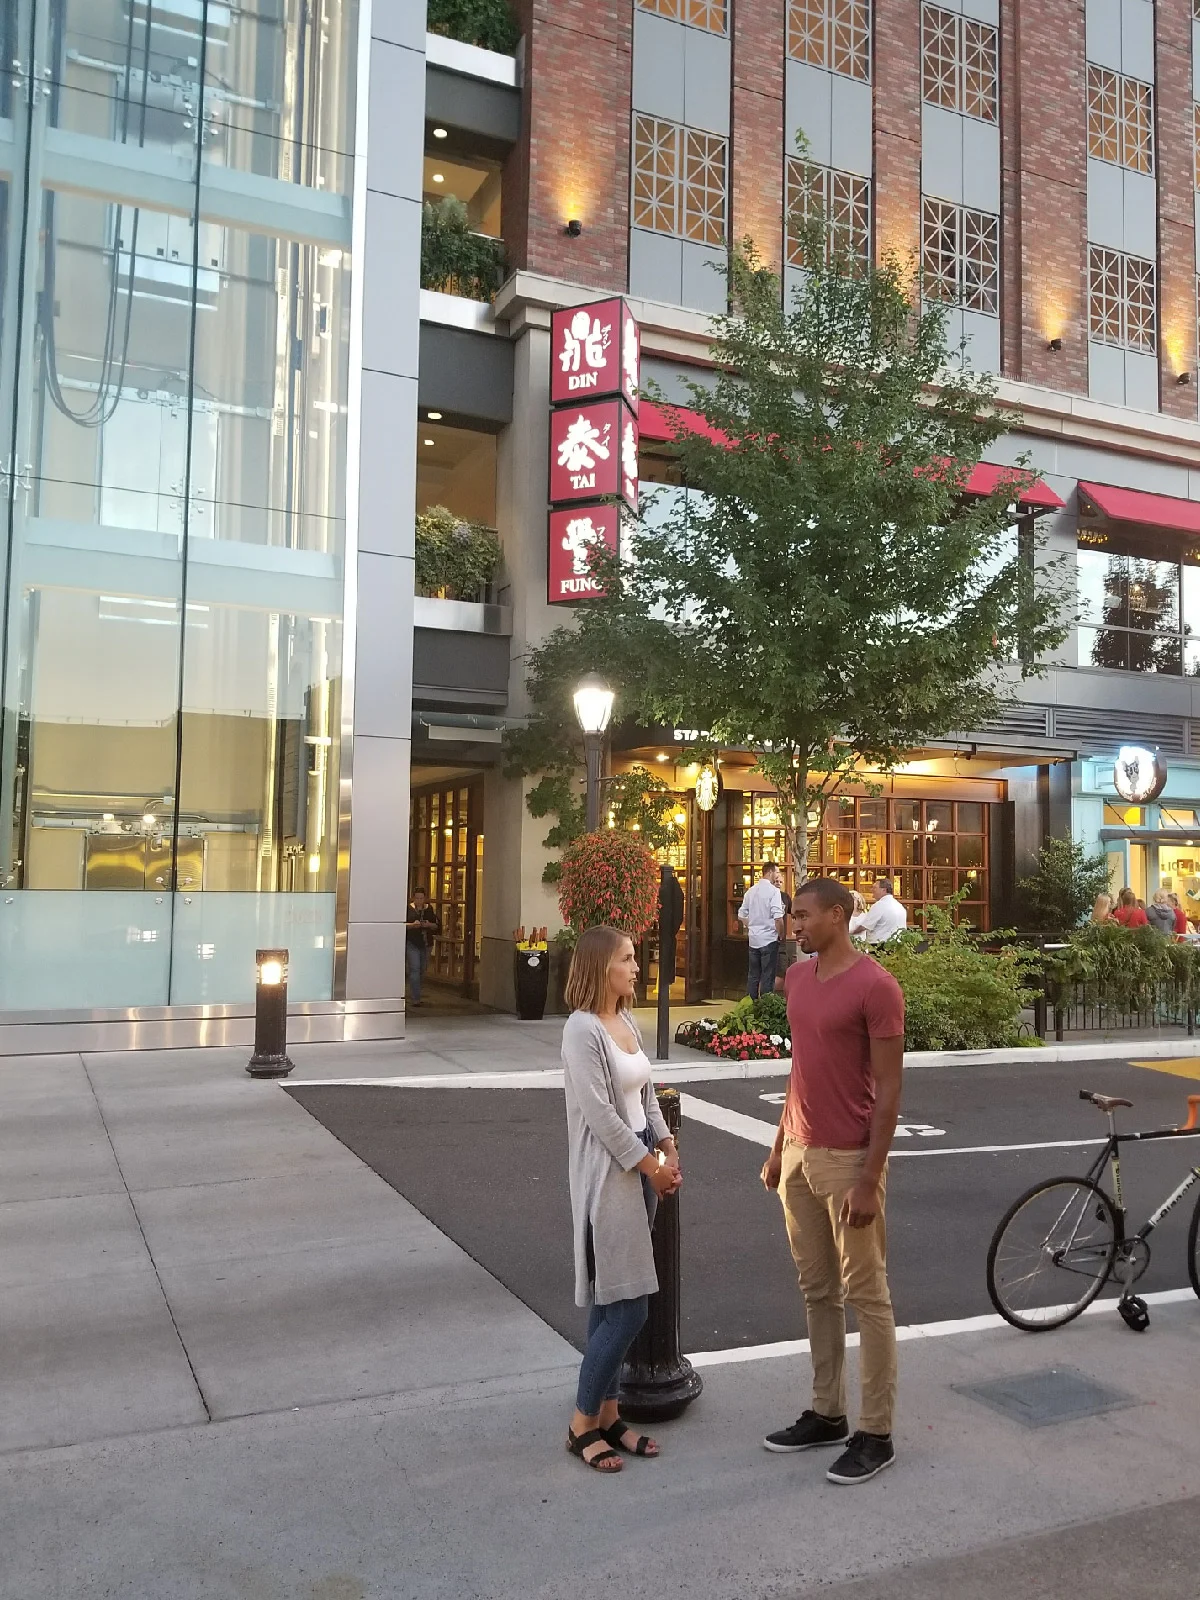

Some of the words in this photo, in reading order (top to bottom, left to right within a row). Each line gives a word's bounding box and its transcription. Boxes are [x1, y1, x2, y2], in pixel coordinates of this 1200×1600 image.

[568, 371, 598, 390] DIN
[557, 414, 610, 472] 泰
[569, 473, 596, 489] TAI
[1168, 861, 1184, 872] ICE
